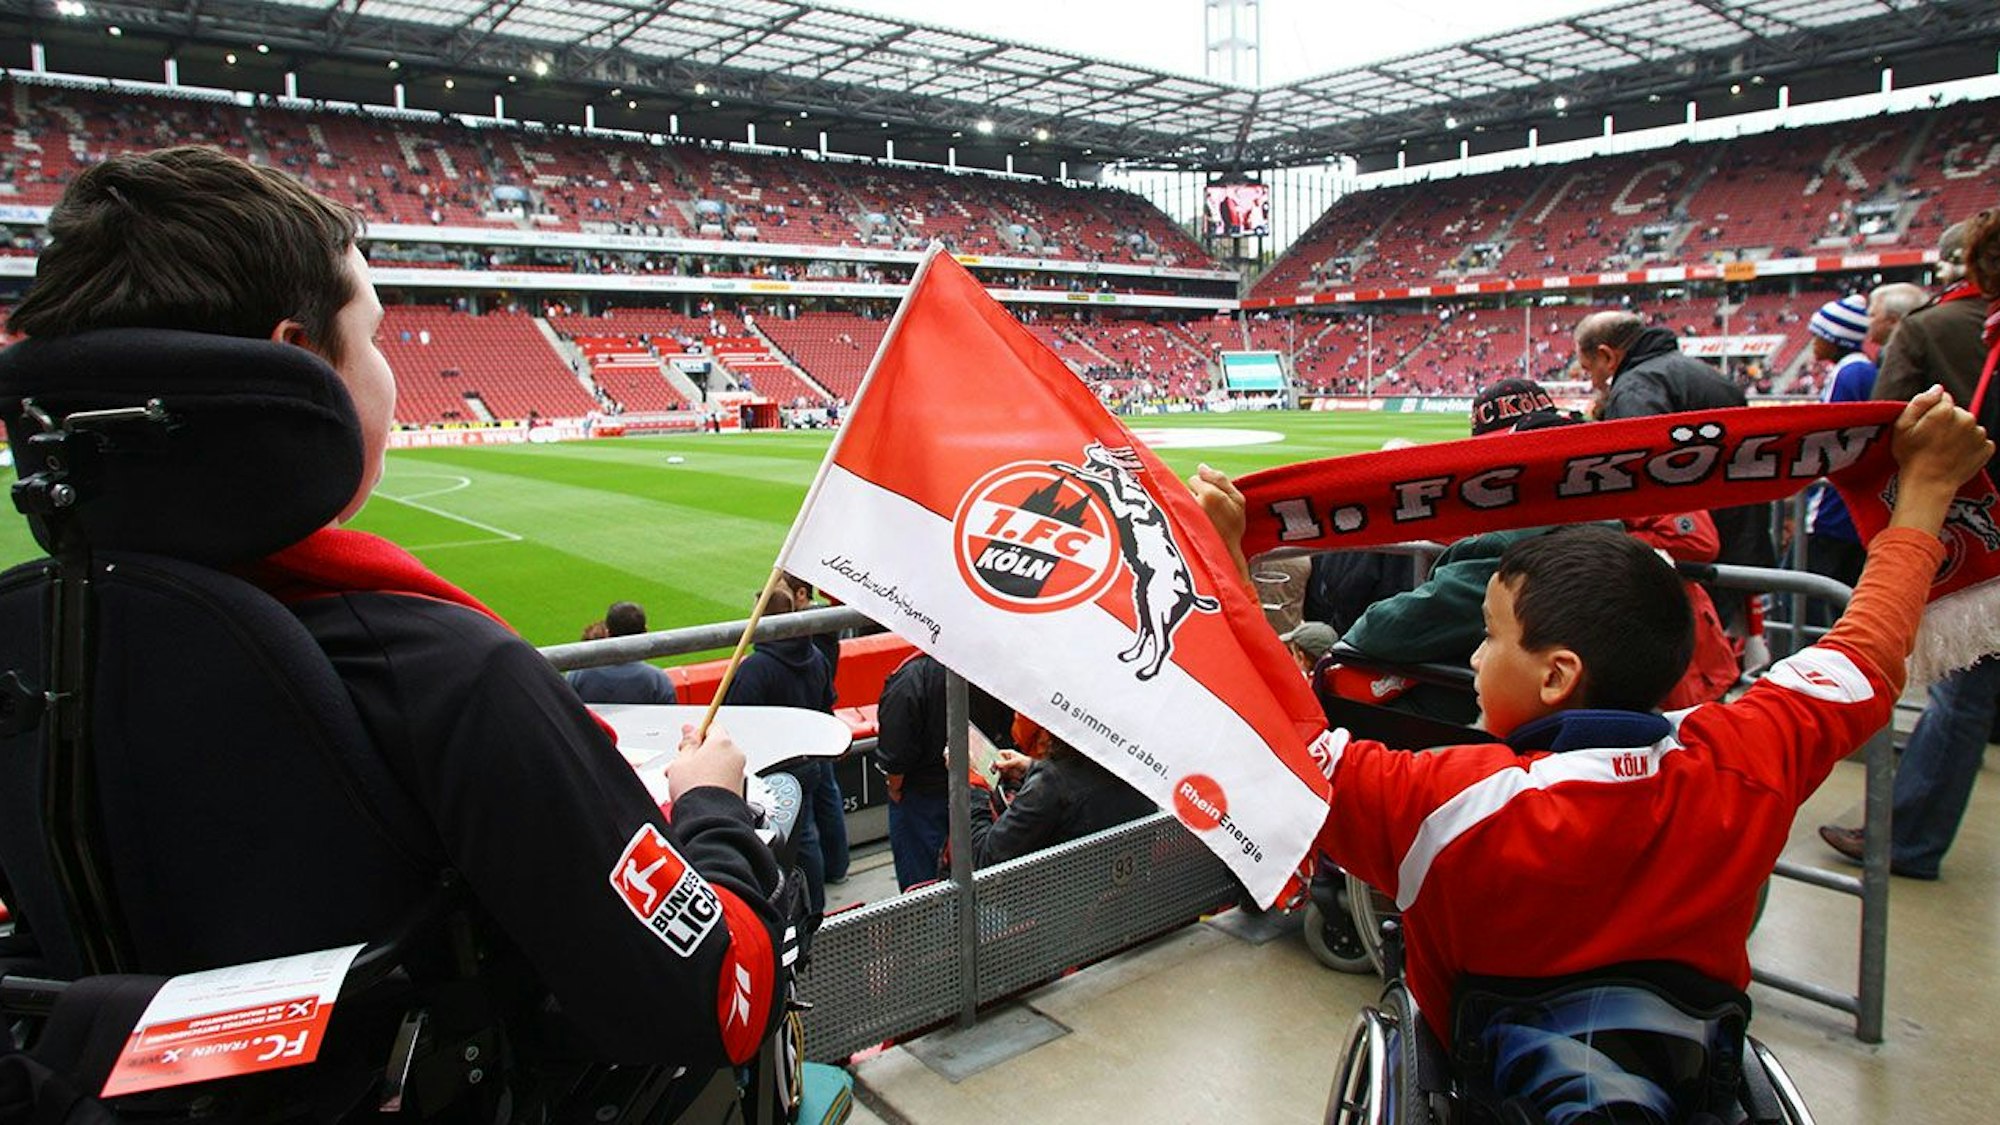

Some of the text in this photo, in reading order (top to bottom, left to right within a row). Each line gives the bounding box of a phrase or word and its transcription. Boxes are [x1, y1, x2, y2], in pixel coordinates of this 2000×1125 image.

[1496, 391, 1555, 420] Köln
[1271, 422, 1882, 541] 1. FC KÖLN
[984, 507, 1092, 558] 1.FC
[976, 545, 1054, 581] KÖLN
[1051, 691, 1169, 780] Da simmer dabei.
[1612, 752, 1648, 777] KÖLN
[1115, 855, 1133, 879] 93
[665, 885, 719, 953] LIGA
[191, 1038, 250, 1058] FRAUEN
